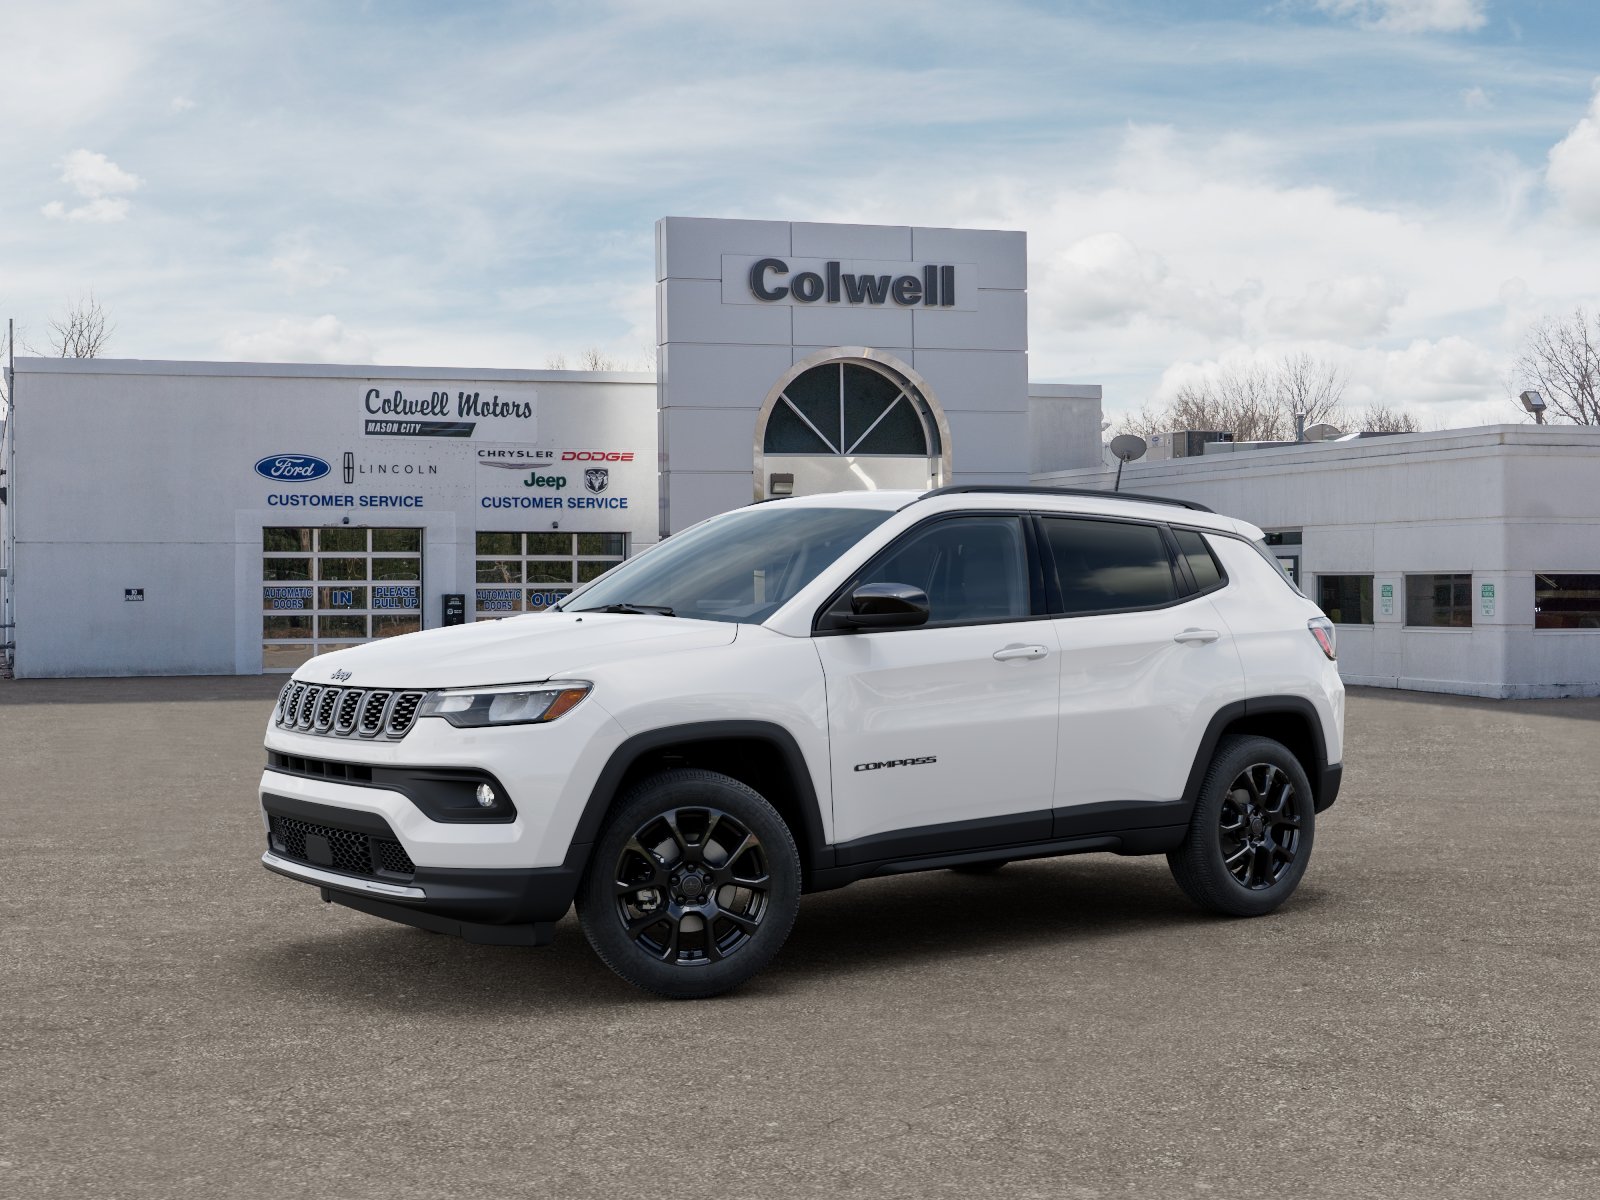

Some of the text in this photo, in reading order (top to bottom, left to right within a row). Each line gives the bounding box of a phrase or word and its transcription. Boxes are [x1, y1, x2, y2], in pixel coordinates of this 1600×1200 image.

[750, 258, 955, 307] Colwell
[365, 388, 532, 418] Colwell Motors
[367, 422, 421, 433] MASON CITY
[477, 449, 554, 458] CHRYSLER
[561, 451, 635, 462] DODGE
[271, 457, 315, 477] Ford
[359, 464, 438, 474] LINCOLN
[523, 471, 567, 490] Jeep
[267, 494, 424, 508] CUSTOMER SERVICE
[481, 496, 628, 509] CUSTOMER SERVICE
[264, 587, 313, 598] AUTOMATIC
[375, 586, 416, 598] PLEASE
[476, 589, 522, 600] AUTOMATIC
[273, 598, 304, 609] DOORS
[332, 591, 353, 606] IN
[373, 597, 419, 609] PULL UP
[484, 600, 513, 611] DOORS
[331, 668, 353, 683] Jeep
[853, 755, 937, 772] COMPASS
